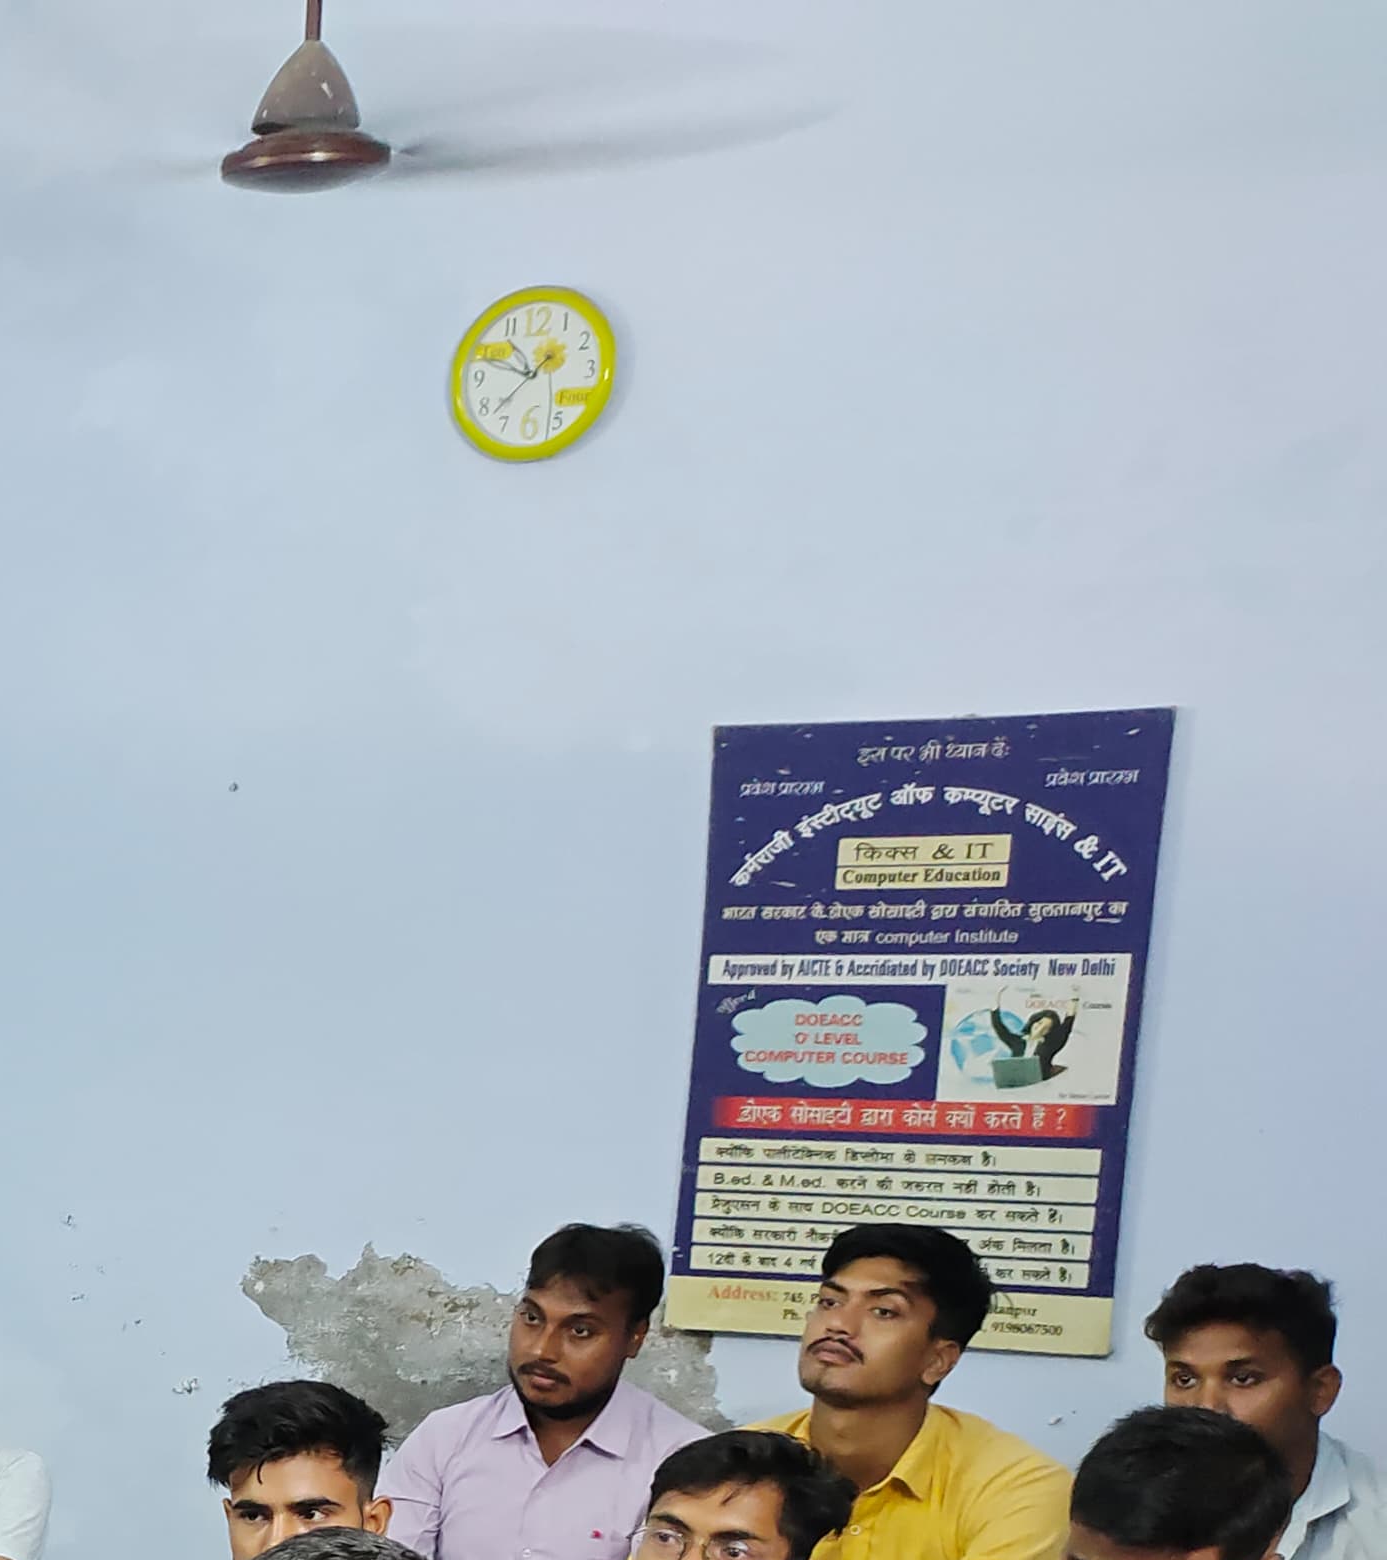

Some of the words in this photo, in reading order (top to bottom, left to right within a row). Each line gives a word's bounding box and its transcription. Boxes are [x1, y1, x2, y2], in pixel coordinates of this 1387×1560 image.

[505, 317, 518, 336] 11
[525, 306, 553, 337] 12
[562, 312, 569, 331] 1
[579, 331, 590, 350] 2
[584, 360, 595, 378] 3
[474, 370, 485, 388] 9
[479, 397, 490, 416] 8
[498, 416, 509, 433] 7
[519, 405, 540, 440] 6
[552, 411, 563, 430] 5
[891, 745, 914, 761] पर
[919, 739, 941, 761] भी
[945, 742, 988, 760] ध्यान
[889, 782, 936, 805] ऑफ
[943, 786, 1021, 815] कम्प्यूटर
[1025, 802, 1077, 840] साइंस
[1073, 835, 1099, 859] &
[1092, 850, 1128, 882] IT
[932, 843, 955, 860] &
[966, 842, 995, 860] IT
[842, 869, 918, 887] Computer
[923, 867, 1001, 883] Education
[815, 930, 838, 944] एक
[875, 931, 950, 947] computer
[955, 929, 1019, 944] Institute
[723, 959, 777, 981] Approved
[781, 960, 794, 980] by
[798, 959, 831, 977] AICTE
[921, 960, 936, 980] by
[939, 959, 990, 976] DOEACC
[993, 957, 1040, 980] Society
[1048, 958, 1076, 976] New
[1081, 957, 1116, 976] Delhi
[794, 1013, 863, 1026] DOEACC
[813, 1032, 862, 1046] LEVEL
[745, 1050, 835, 1064] COMPUTER
[842, 1051, 909, 1066] COURSE
[902, 1102, 937, 1129] कोर्स
[984, 1105, 1023, 1130] करते
[1056, 1108, 1067, 1130] ?
[714, 1172, 755, 1186] B.ed.
[762, 1174, 774, 1187] &
[780, 1174, 826, 1189] M.ed.
[822, 1201, 900, 1217] DOEACC
[906, 1204, 967, 1219] Course
[784, 1257, 792, 1267] 4
[708, 1285, 779, 1303] Address:
